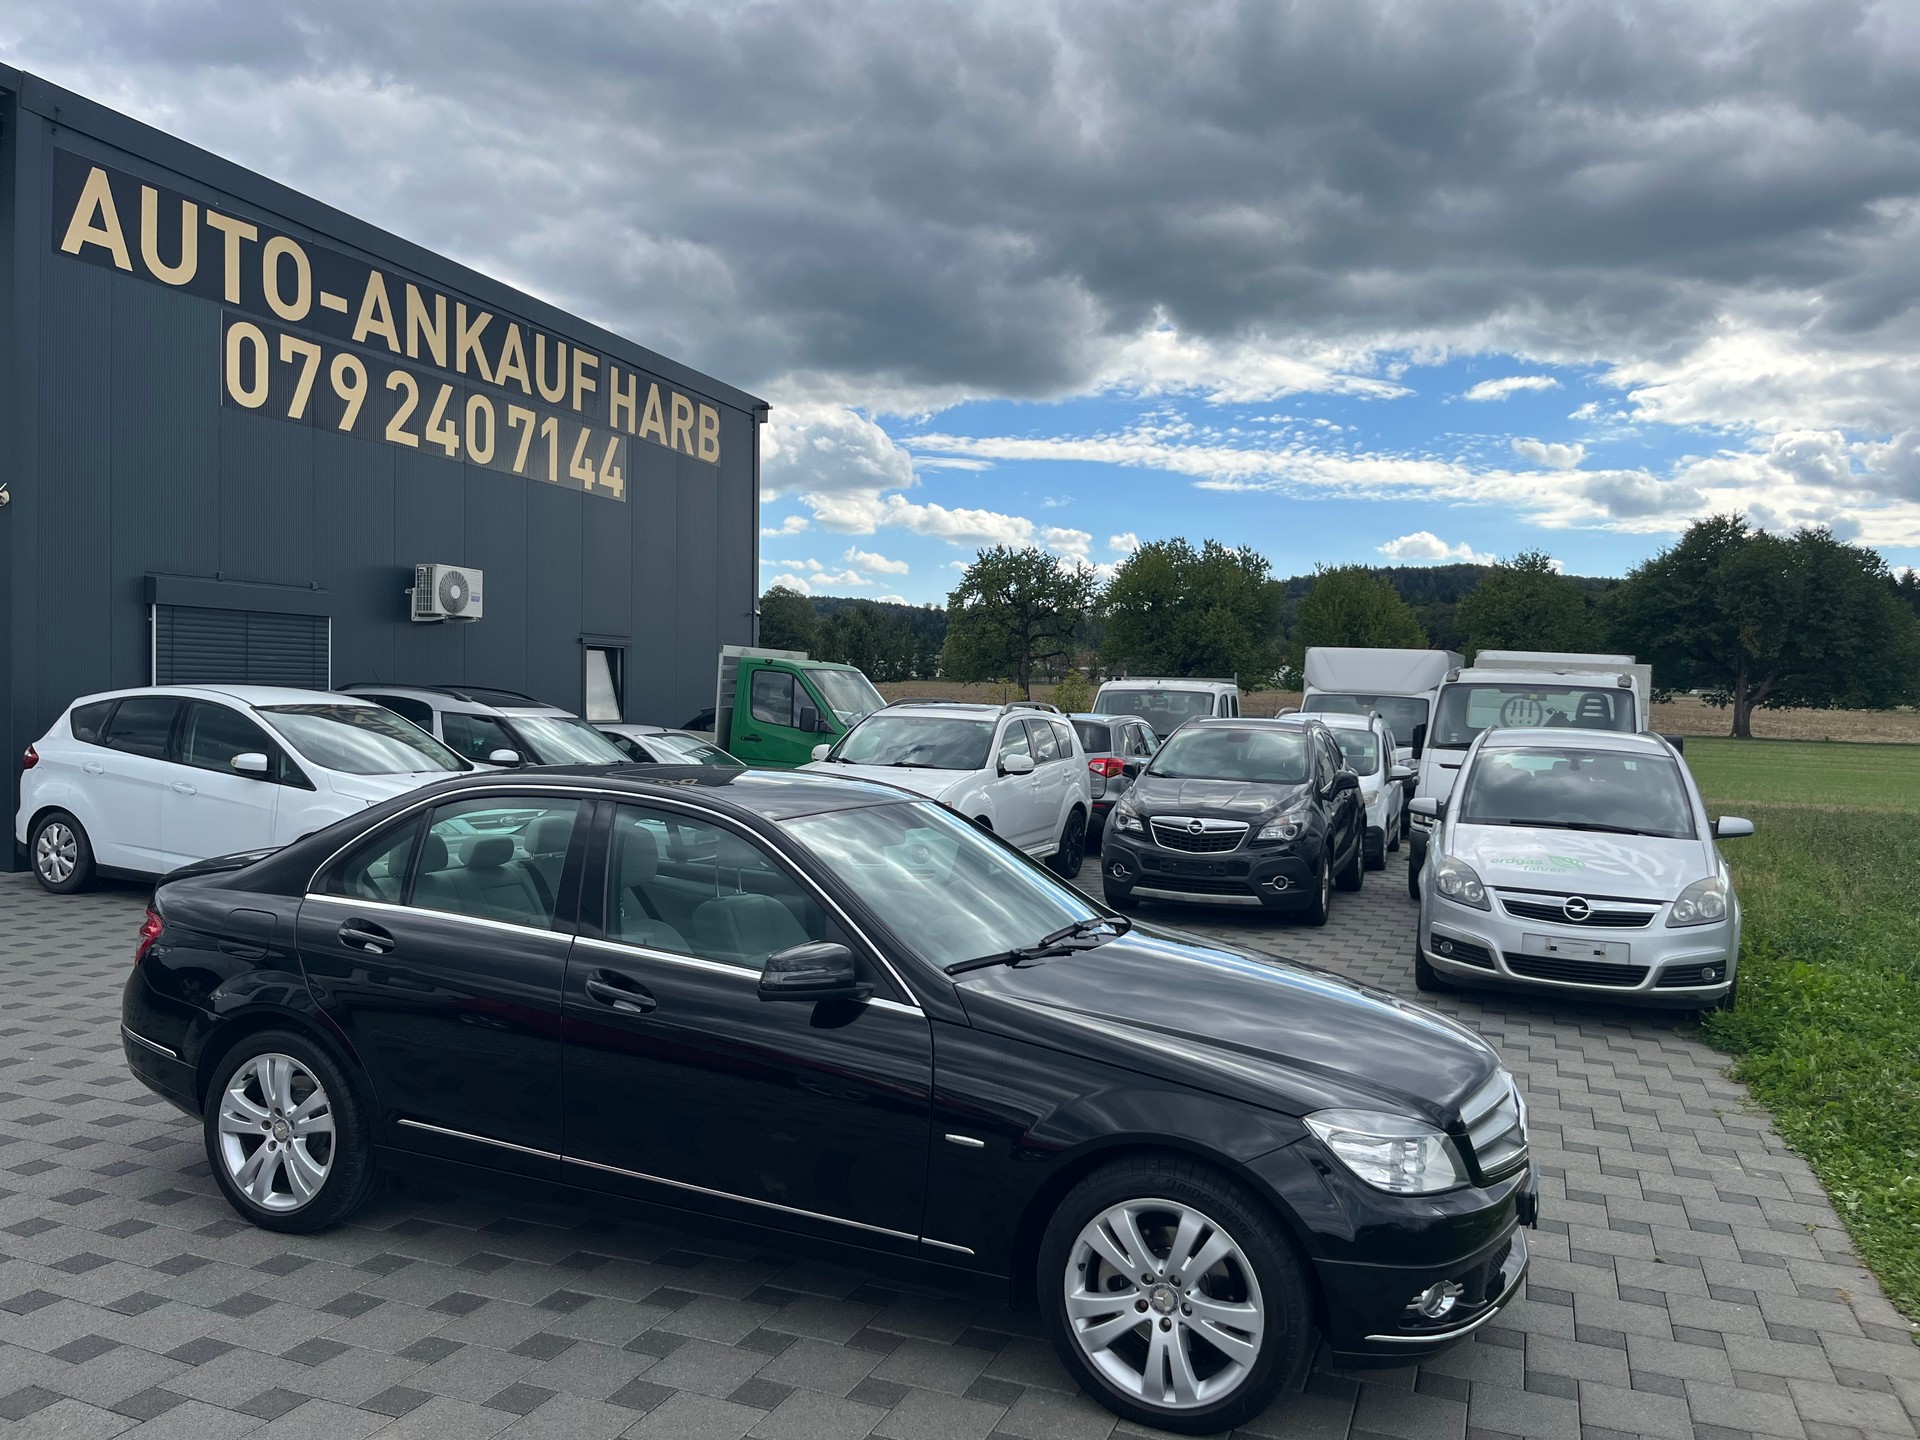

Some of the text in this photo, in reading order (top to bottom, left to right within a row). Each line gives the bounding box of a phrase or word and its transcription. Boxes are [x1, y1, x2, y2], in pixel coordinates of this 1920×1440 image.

[62, 168, 720, 463] AUTO-ANKAUF HARB
[226, 322, 368, 431] 079
[385, 370, 495, 465] 240
[1490, 857, 1543, 866] erdgas
[1523, 865, 1566, 873] fahren
